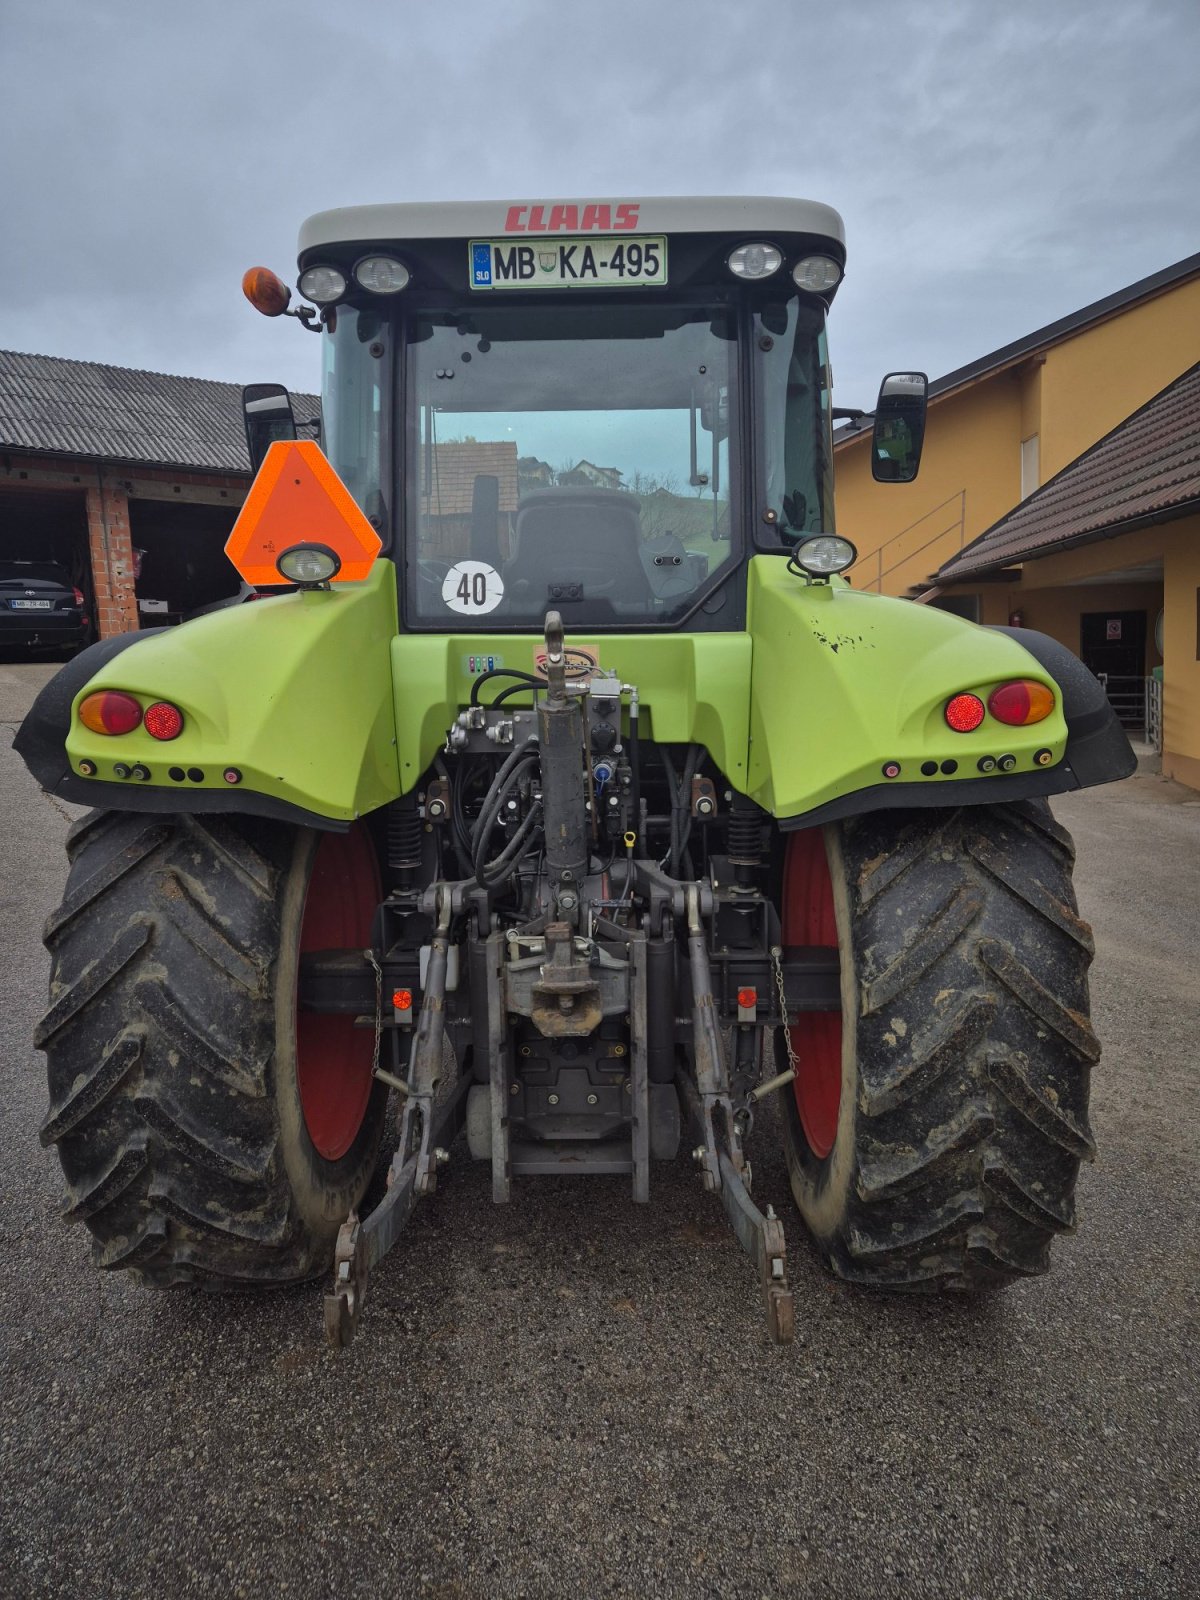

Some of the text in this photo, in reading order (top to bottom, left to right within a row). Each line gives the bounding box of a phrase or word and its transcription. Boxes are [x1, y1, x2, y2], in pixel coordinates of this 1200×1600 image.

[505, 204, 640, 231] CLAAS
[476, 271, 490, 281] SLO
[494, 244, 660, 280] MB KA-495
[456, 573, 487, 606] 40
